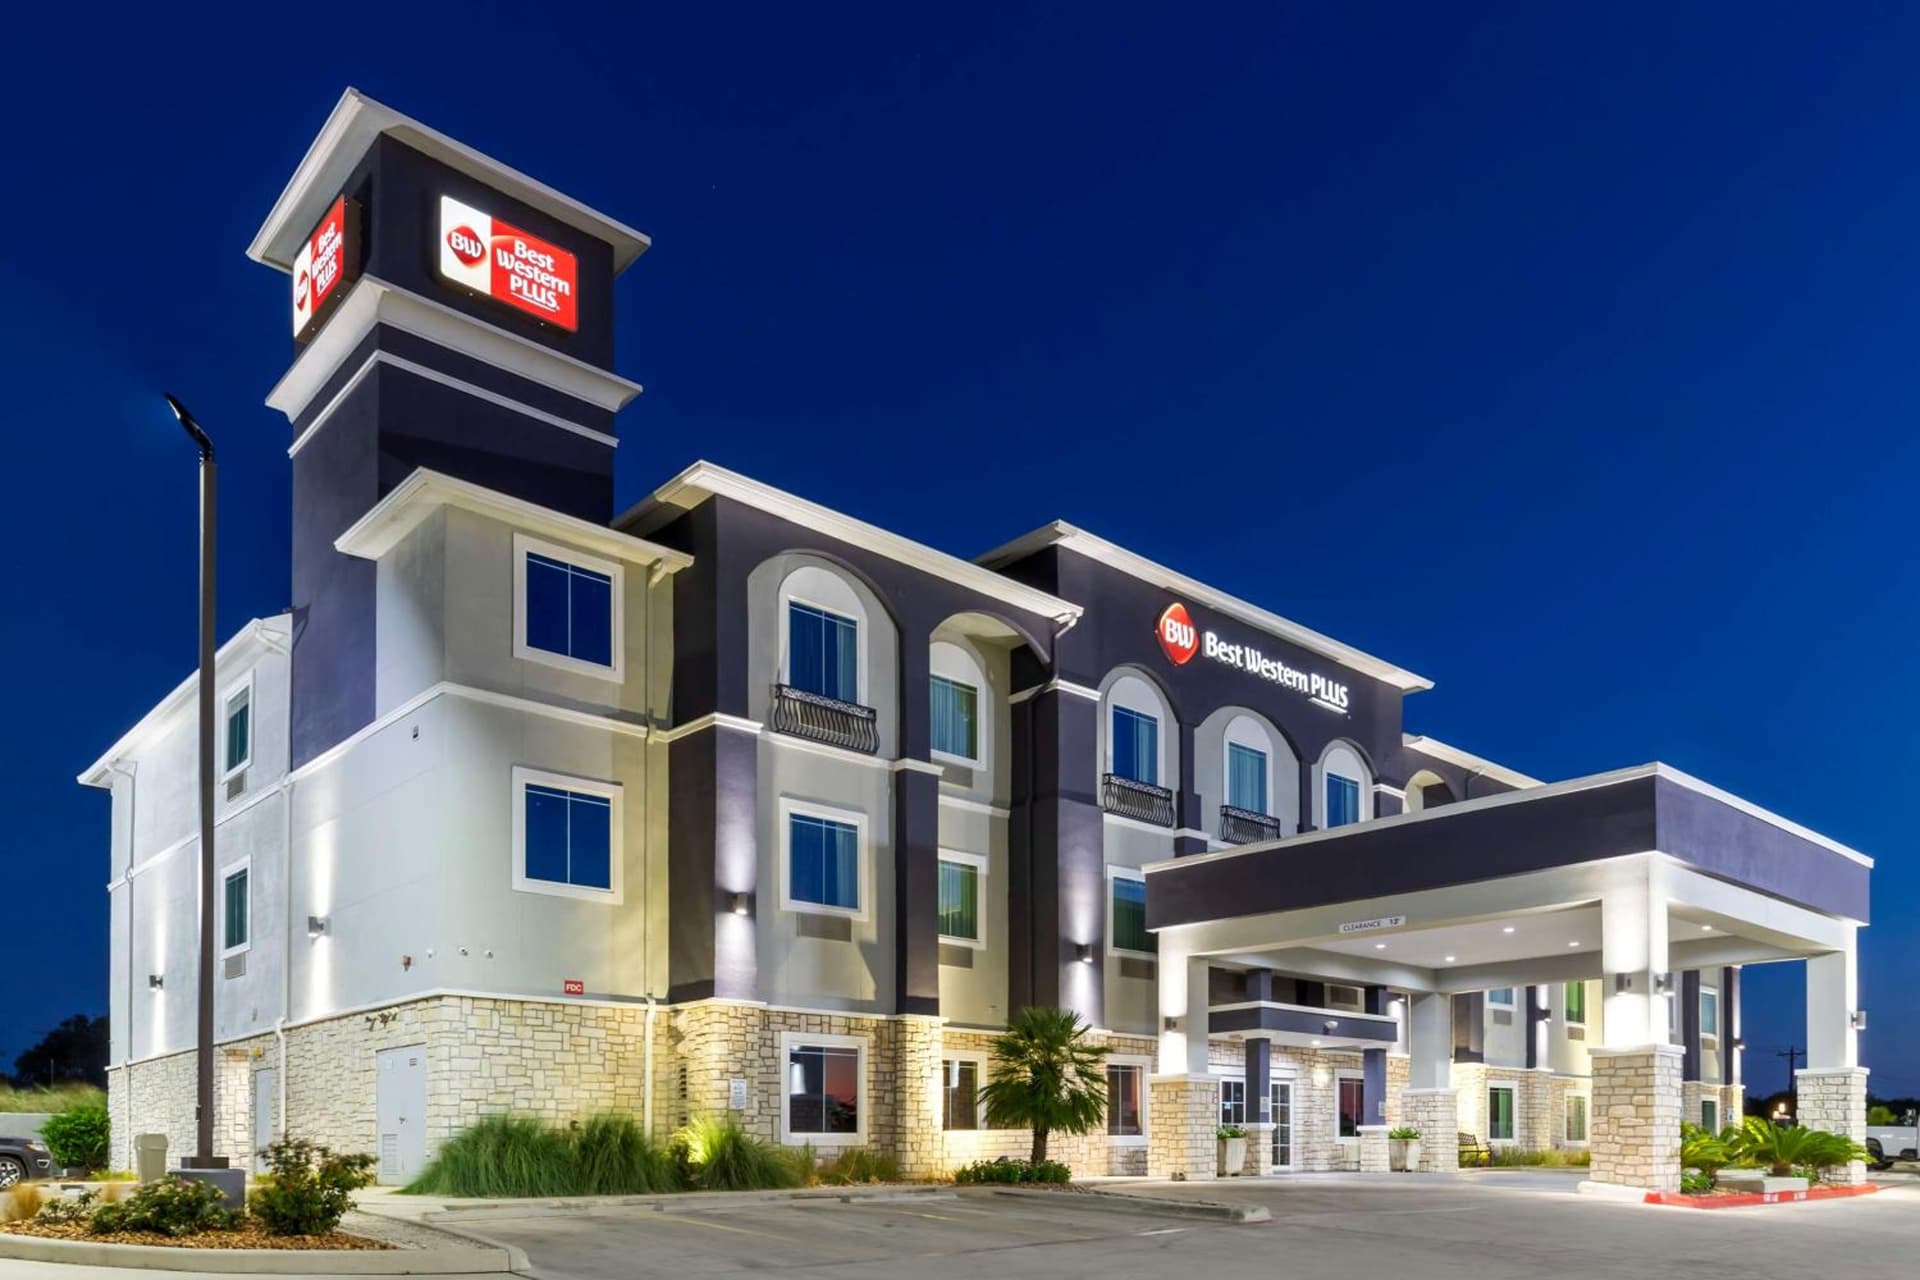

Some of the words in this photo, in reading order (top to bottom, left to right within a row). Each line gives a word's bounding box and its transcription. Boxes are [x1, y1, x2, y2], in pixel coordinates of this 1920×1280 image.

[450, 231, 482, 259] BW
[514, 239, 555, 271] Best
[496, 248, 570, 296] Western
[509, 274, 558, 309] PLUS
[1165, 618, 1195, 650] BW
[1204, 631, 1244, 668] Best
[1244, 647, 1309, 693] Western
[1310, 673, 1350, 709] PLUS
[1343, 920, 1381, 932] CLEARANCE
[566, 983, 582, 992] FDC
